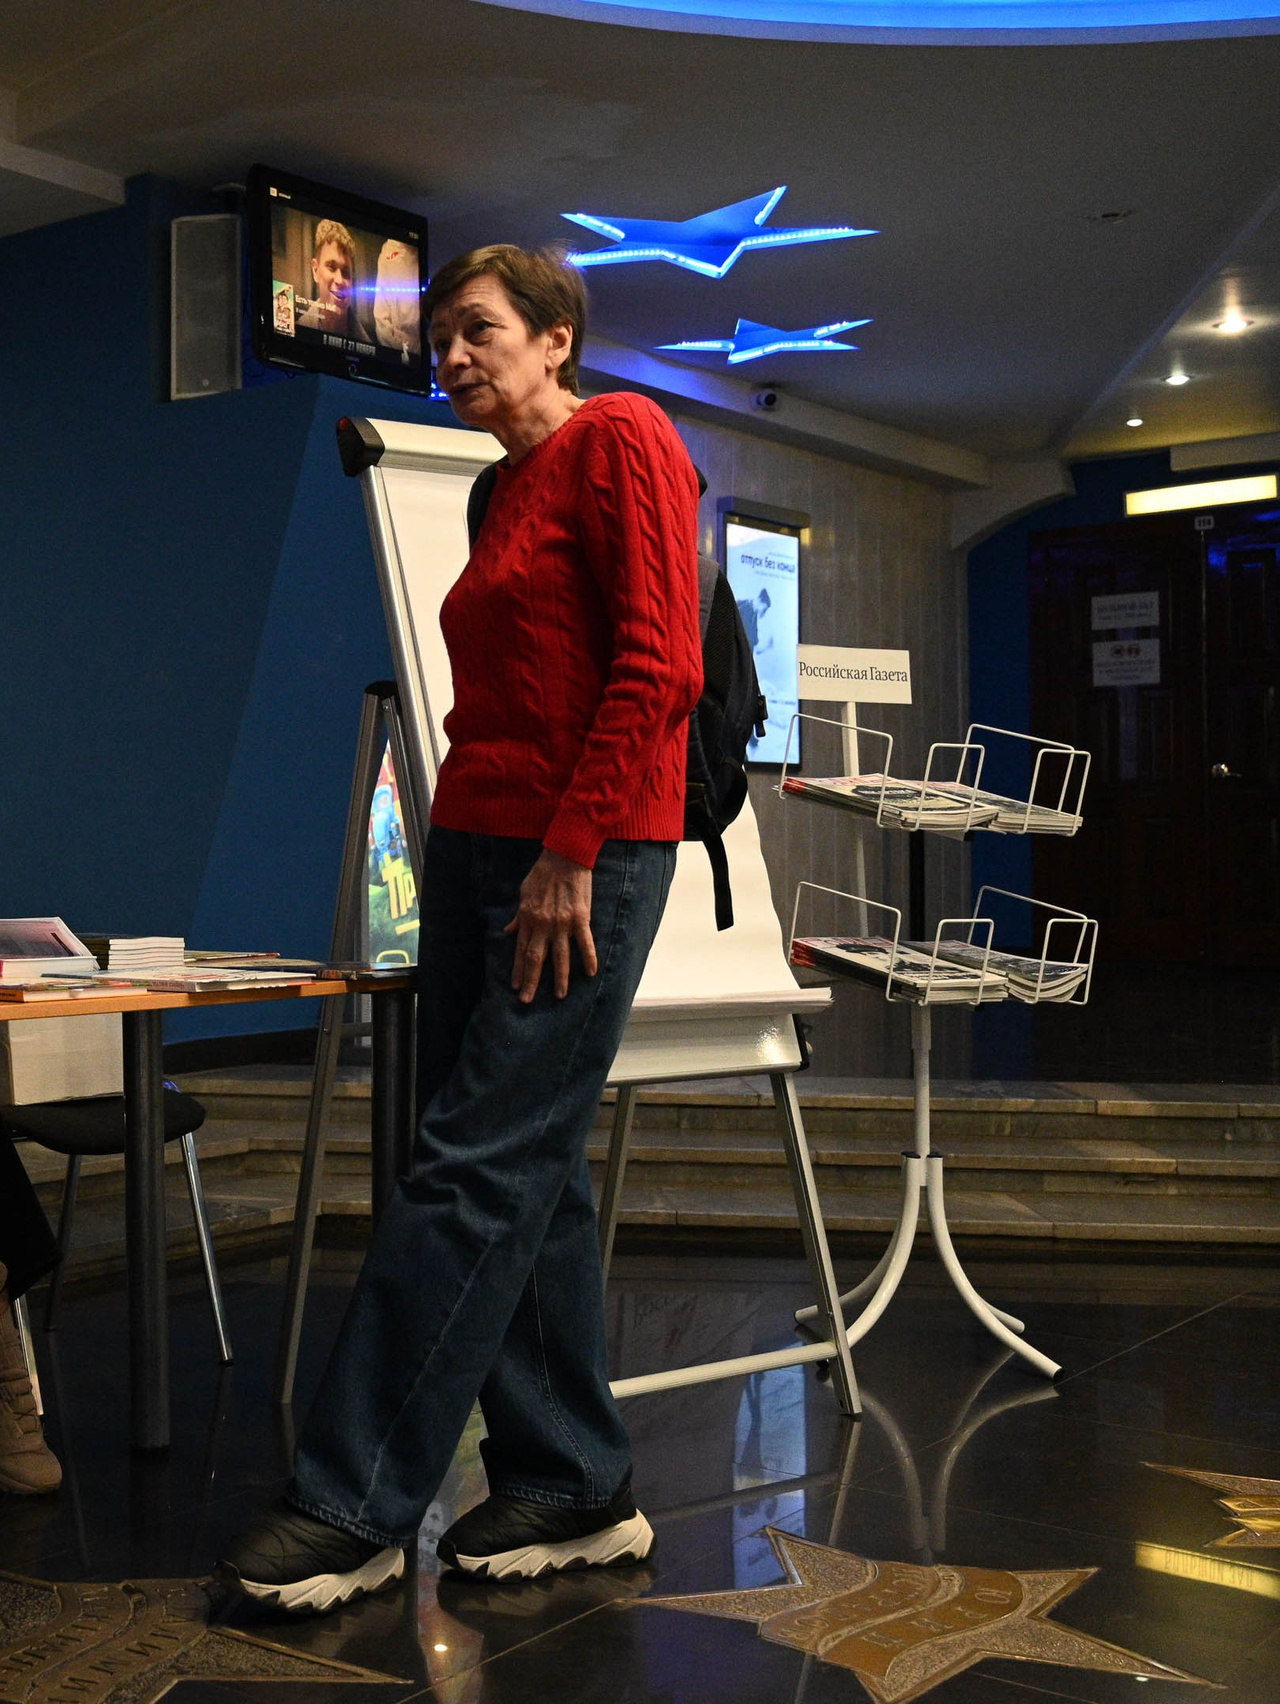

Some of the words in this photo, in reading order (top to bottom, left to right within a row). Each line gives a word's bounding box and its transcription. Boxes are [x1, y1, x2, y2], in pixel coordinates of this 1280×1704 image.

[764, 556, 776, 570] без
[798, 661, 868, 680] Российская
[869, 666, 909, 682] Газета
